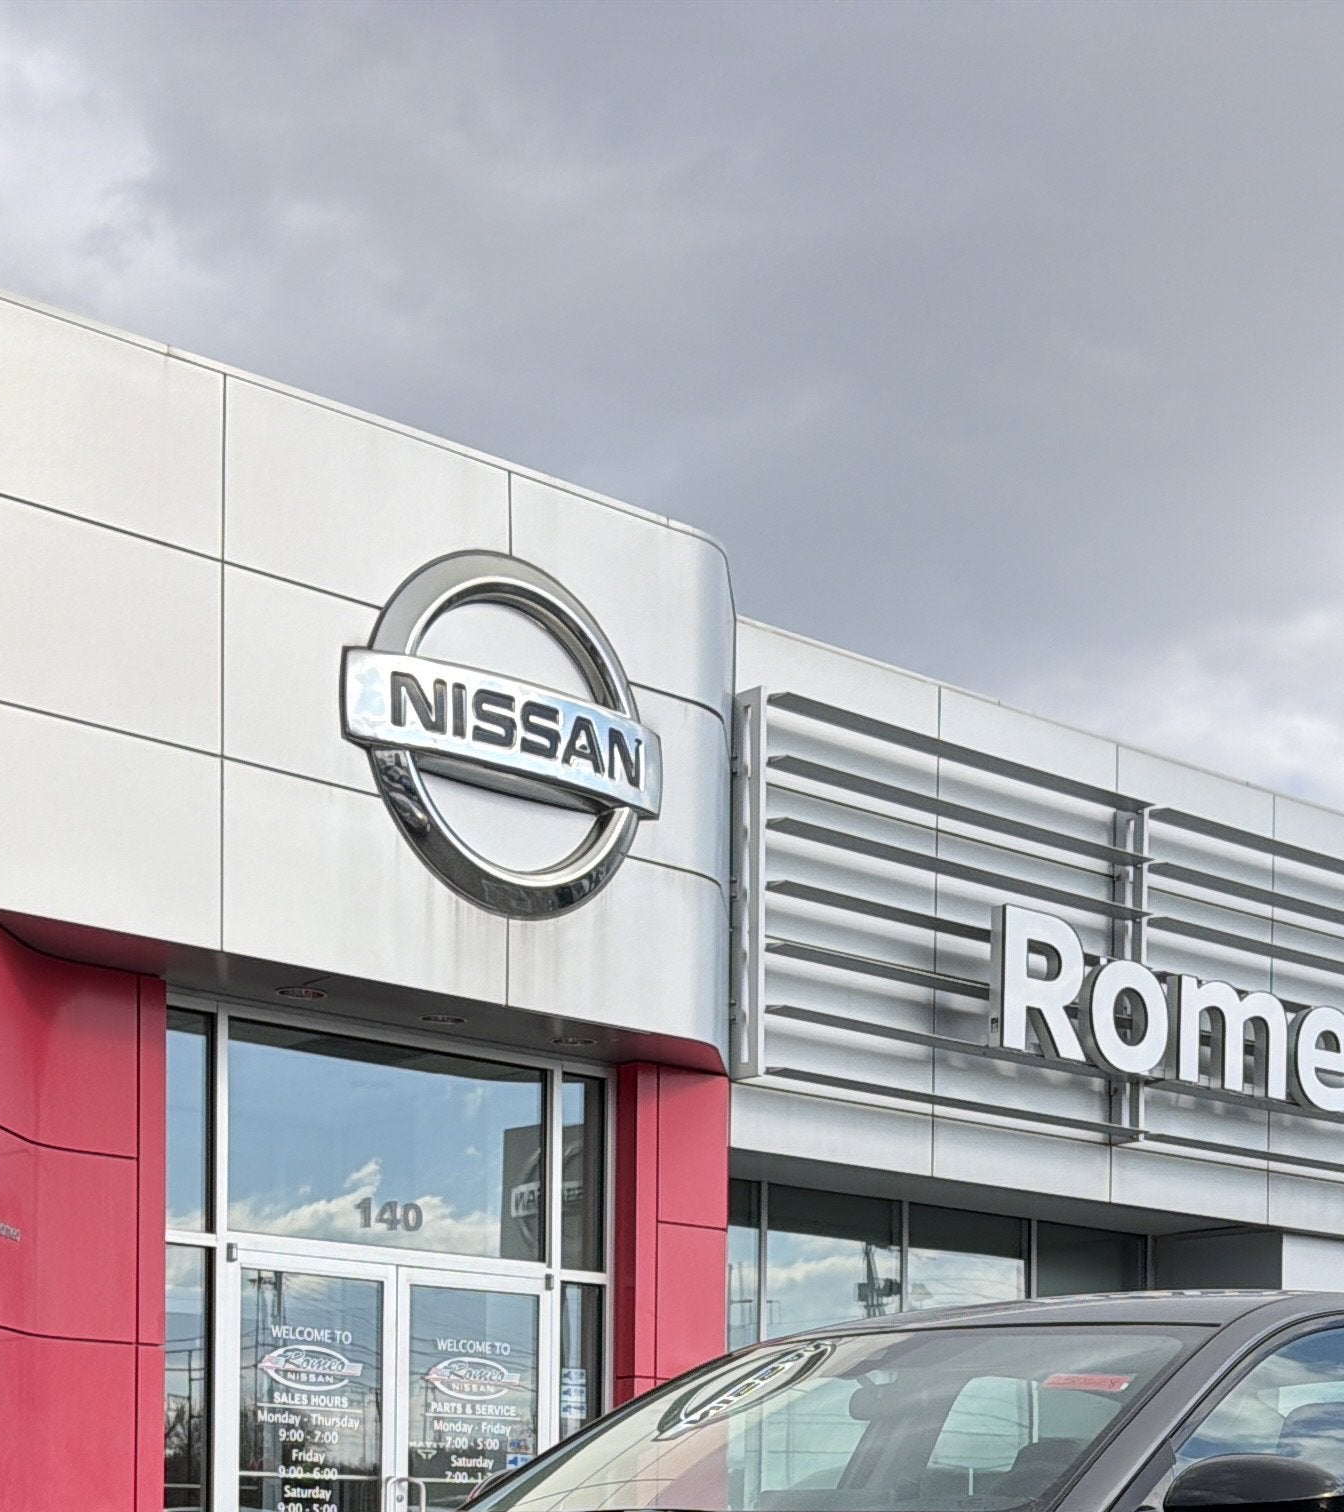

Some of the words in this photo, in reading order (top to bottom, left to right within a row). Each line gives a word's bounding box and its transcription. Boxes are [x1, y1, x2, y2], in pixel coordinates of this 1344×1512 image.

[390, 671, 645, 792] NISSAN
[354, 1197, 423, 1232] 140
[271, 1324, 332, 1344] WELCOME
[335, 1329, 353, 1345] TO
[436, 1338, 492, 1354] WELCOME
[494, 1342, 511, 1356] TO
[283, 1347, 346, 1373] Romeo
[287, 1371, 334, 1384] NISSAN
[452, 1382, 495, 1393] NISSAN
[273, 1391, 309, 1406] SALES
[310, 1395, 348, 1408] HOURS
[430, 1401, 463, 1413] PARTS
[465, 1404, 473, 1415] &
[475, 1404, 517, 1416] SERVICE
[257, 1409, 302, 1427] Monday
[310, 1413, 360, 1430] Thursday
[433, 1420, 474, 1434] Monday
[481, 1422, 512, 1436] Friday
[278, 1428, 305, 1442] 9:00
[313, 1431, 339, 1444] 7:00
[445, 1436, 469, 1449] 7:00
[476, 1438, 500, 1450] 5:00
[291, 1448, 326, 1465] Friday
[450, 1455, 495, 1470] Saturday
[278, 1465, 303, 1479] 9:00
[312, 1467, 338, 1480] 6:00
[283, 1485, 332, 1502] Saturday
